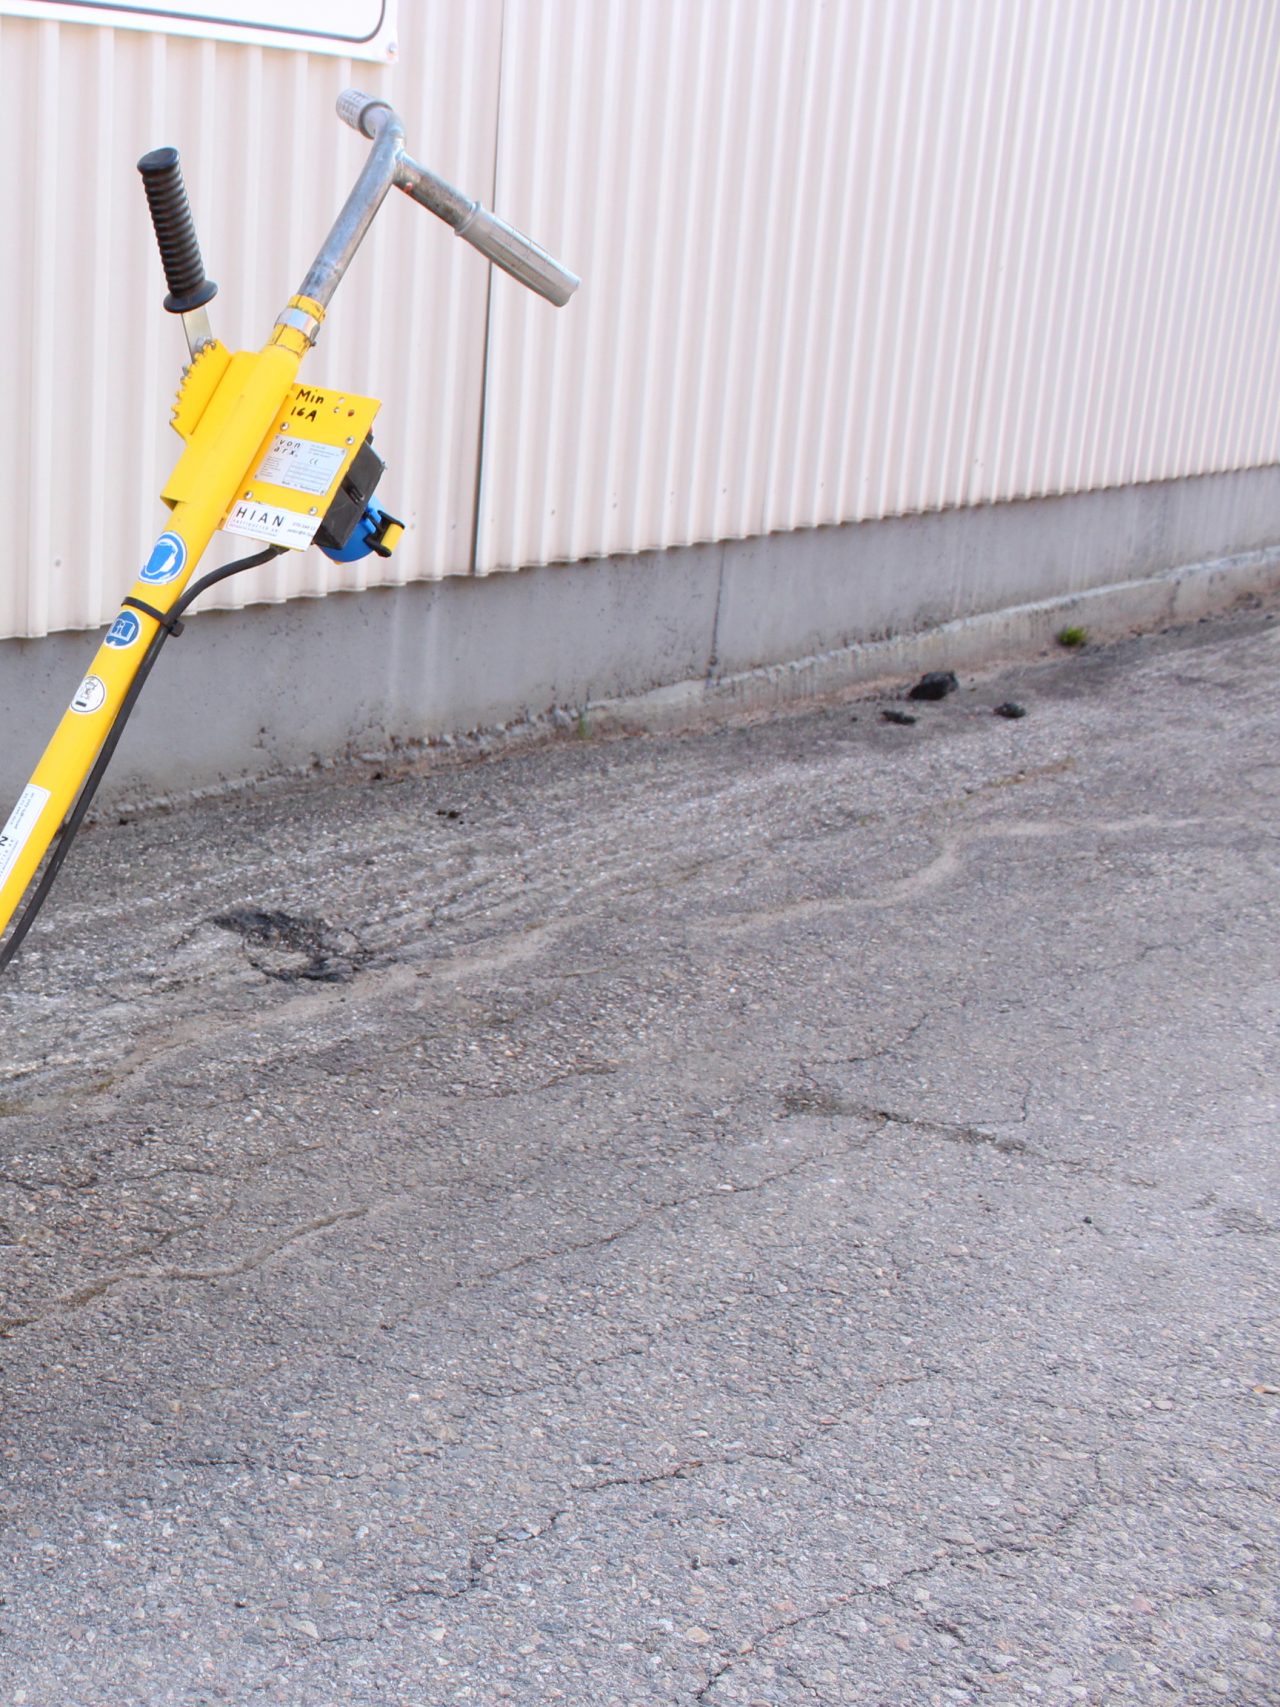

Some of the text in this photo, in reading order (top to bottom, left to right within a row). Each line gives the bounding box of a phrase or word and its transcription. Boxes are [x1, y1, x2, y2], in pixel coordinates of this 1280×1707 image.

[296, 388, 325, 404] Min
[291, 406, 318, 423] 16A
[279, 439, 301, 449] von
[236, 506, 285, 527] HIAN
